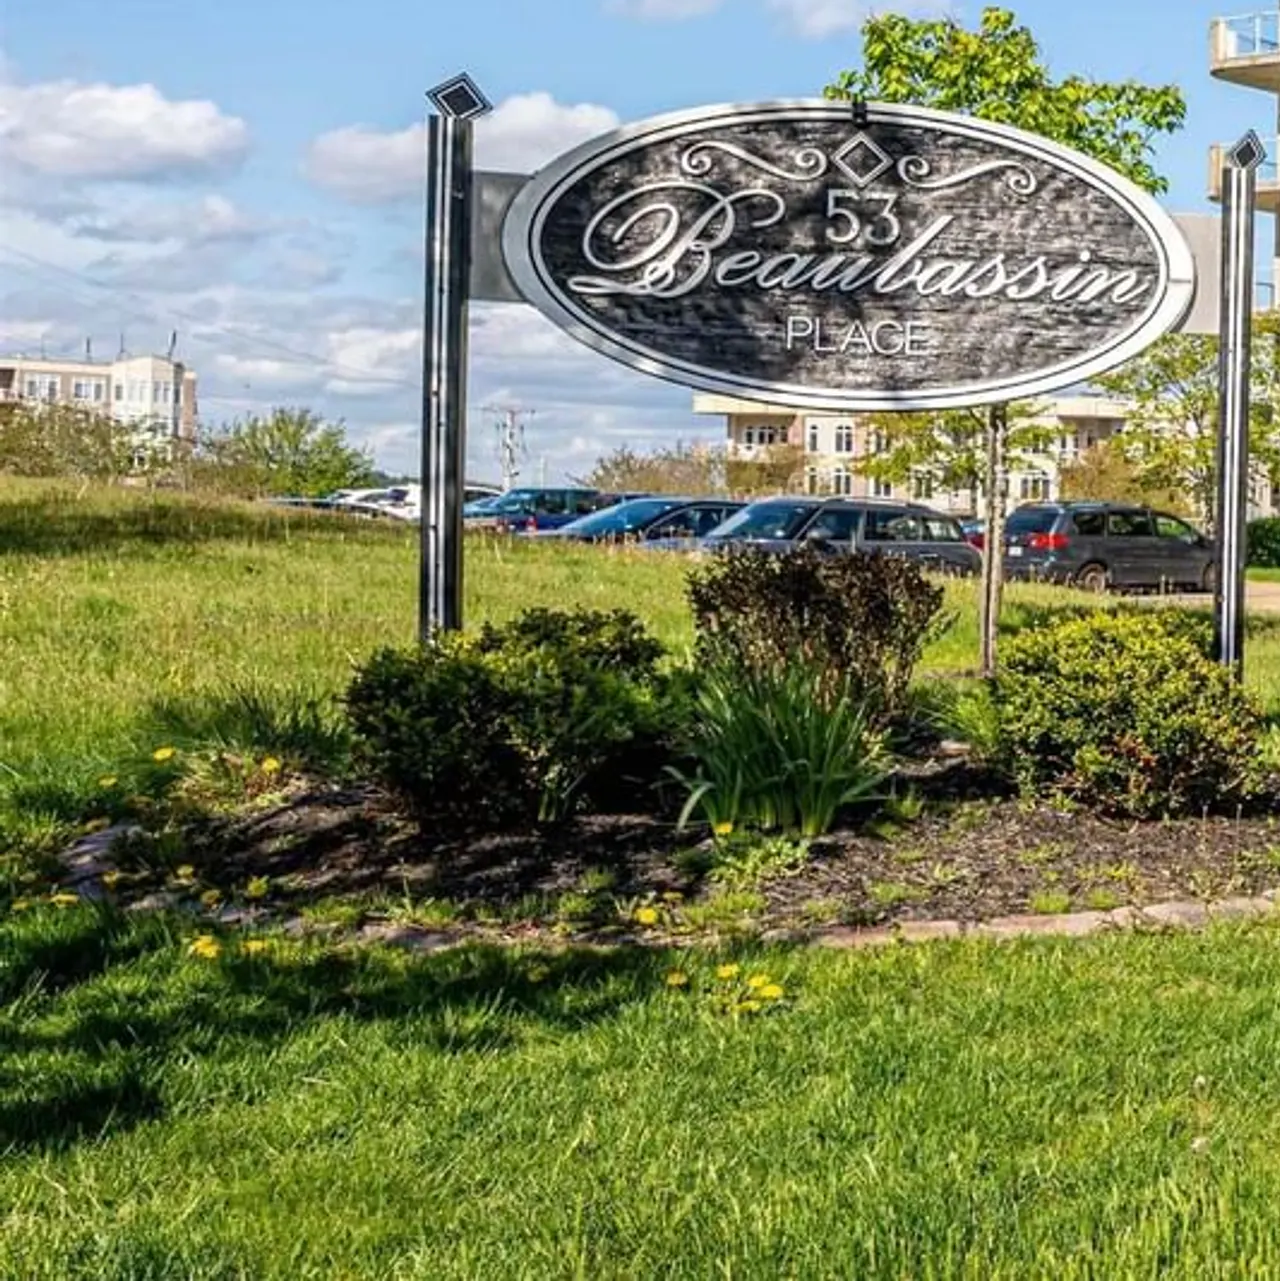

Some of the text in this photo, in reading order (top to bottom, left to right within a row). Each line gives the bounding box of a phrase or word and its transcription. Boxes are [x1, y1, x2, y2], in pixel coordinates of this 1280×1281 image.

[567, 181, 1150, 303] Beaubassin
[825, 188, 900, 245] 53
[786, 315, 928, 356] PLACE
